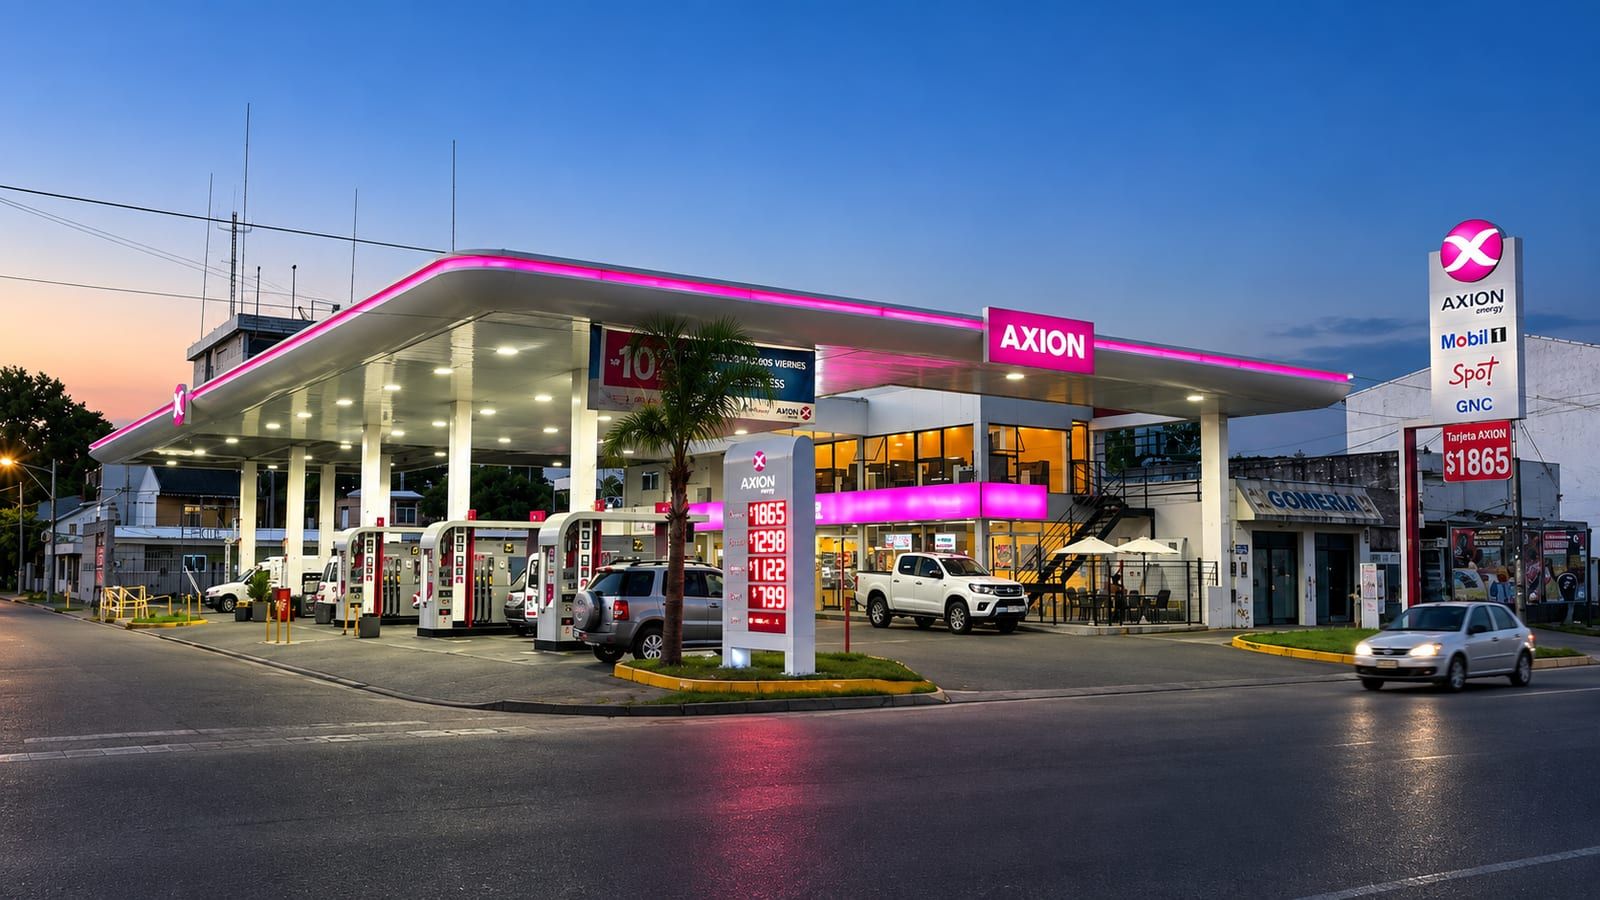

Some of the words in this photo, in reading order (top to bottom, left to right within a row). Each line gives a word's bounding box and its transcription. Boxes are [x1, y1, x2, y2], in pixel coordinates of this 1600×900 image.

[1441, 289, 1504, 311] AXION
[1476, 305, 1504, 314] energy
[1000, 324, 1085, 359] AXION
[1441, 329, 1488, 349] Mobil
[775, 360, 807, 370] VIERNES
[1456, 398, 1493, 413] GNC
[1446, 432, 1476, 444] Tarjeta
[1478, 429, 1507, 440] AXION
[1446, 447, 1509, 475] $1865
[741, 475, 776, 489] AXION
[750, 502, 785, 525] $1865
[750, 530, 785, 553] $1298
[749, 558, 785, 581] $1122
[752, 586, 785, 608] $799
